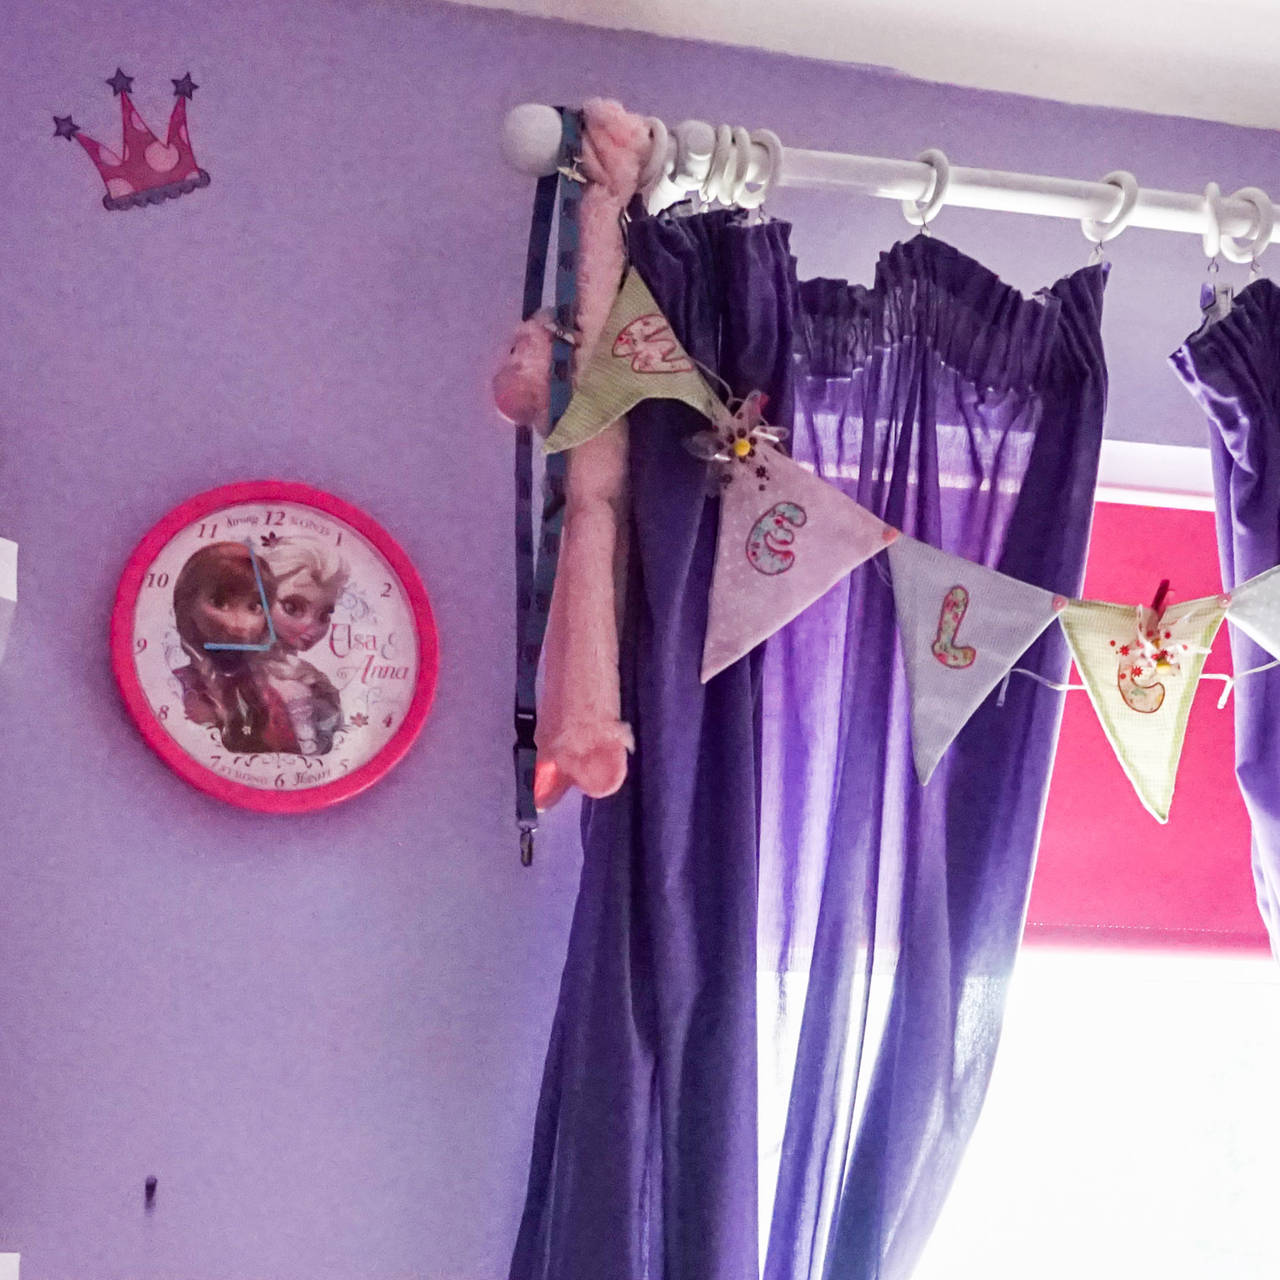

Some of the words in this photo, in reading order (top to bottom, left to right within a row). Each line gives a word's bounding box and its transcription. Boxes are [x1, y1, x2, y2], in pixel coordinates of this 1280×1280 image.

[264, 511, 286, 526] 12
[197, 523, 218, 539] 11
[336, 532, 342, 547] 1
[146, 573, 169, 588] 10
[380, 582, 392, 598] 2
[134, 638, 147, 655] 9
[329, 623, 376, 658] Elsa
[159, 704, 169, 720] 8
[382, 713, 392, 728] 4
[210, 755, 221, 769] 7
[274, 773, 285, 788] 6
